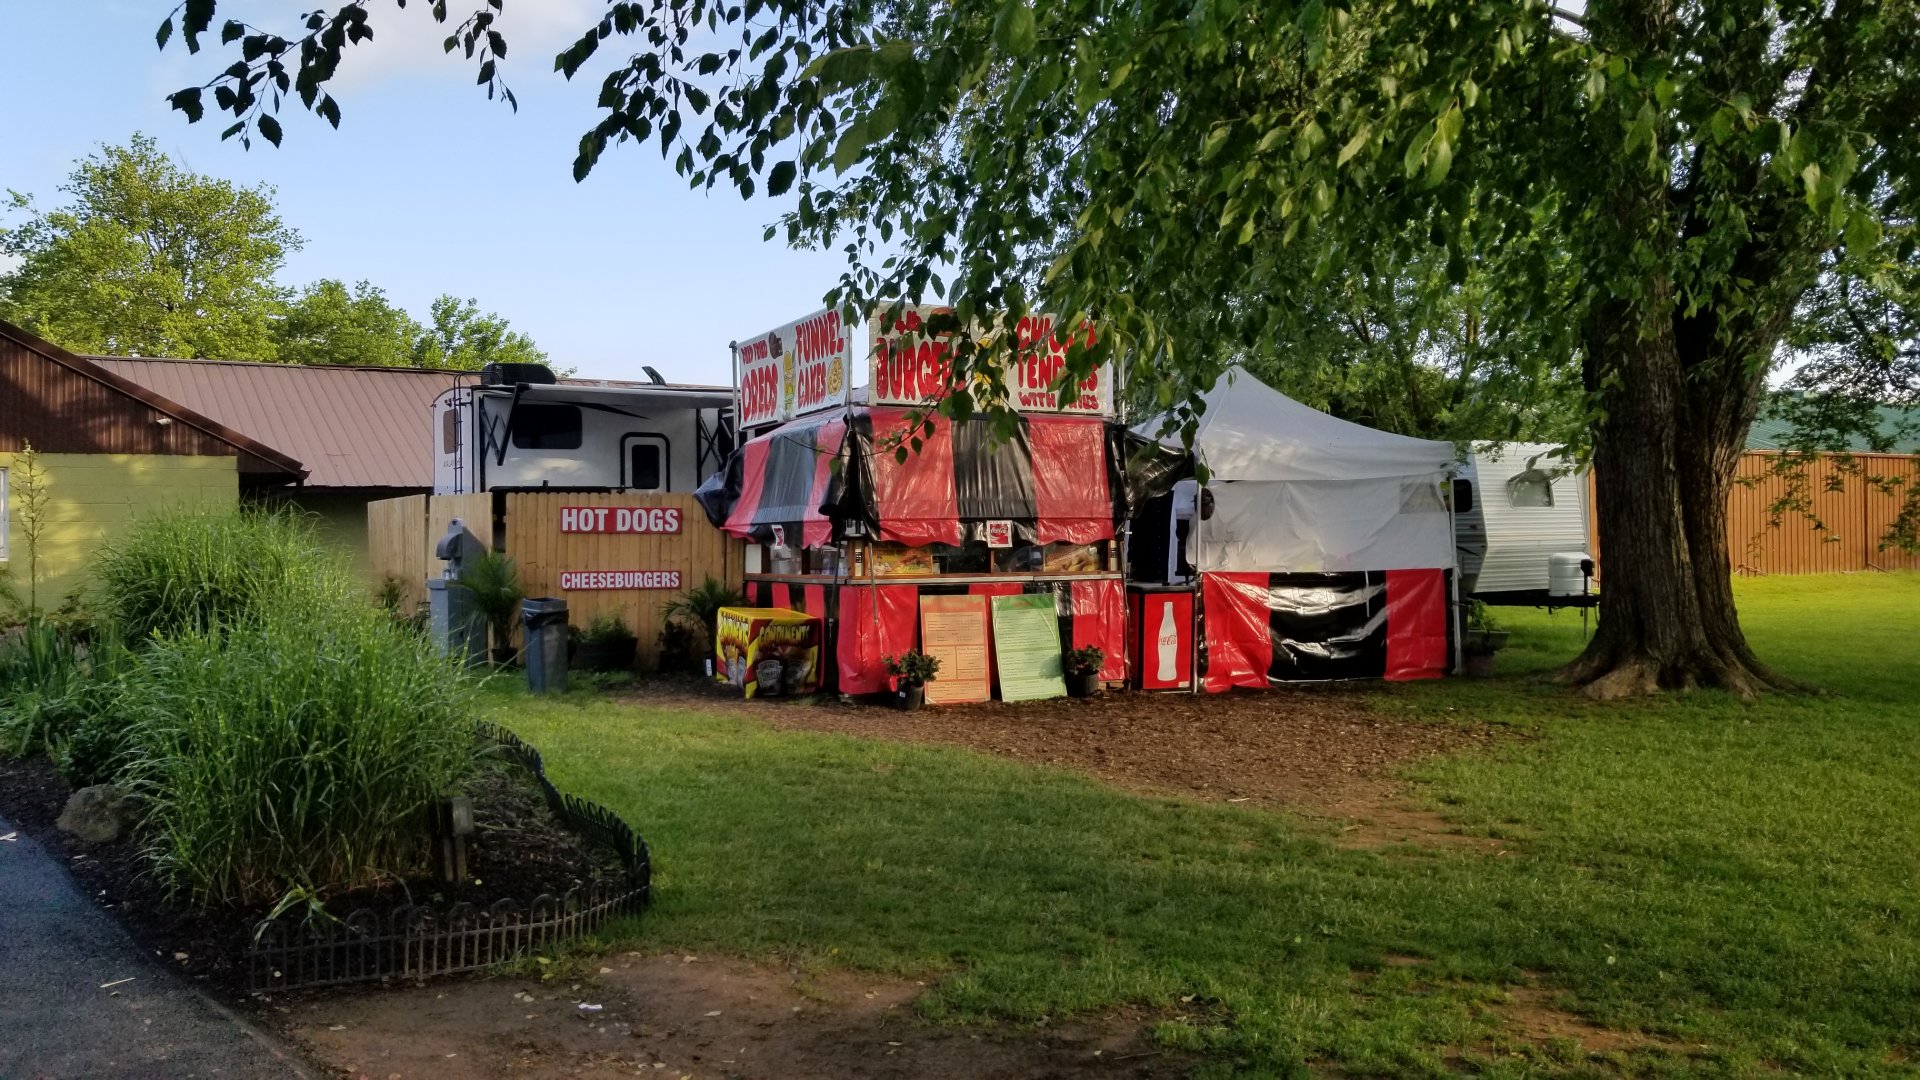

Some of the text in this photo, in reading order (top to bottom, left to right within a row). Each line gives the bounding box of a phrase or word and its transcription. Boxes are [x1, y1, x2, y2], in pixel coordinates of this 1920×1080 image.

[795, 310, 845, 366] FUNNEL
[1016, 316, 1098, 354] CHIC
[797, 361, 827, 410] CAKES
[876, 337, 967, 402] BURGER
[1017, 352, 1099, 392] TENDS
[741, 362, 779, 423] OREOS
[1018, 391, 1099, 410] WITH IES
[562, 507, 680, 533] HOT DOGS
[561, 571, 680, 590] CHEESEBURGERS
